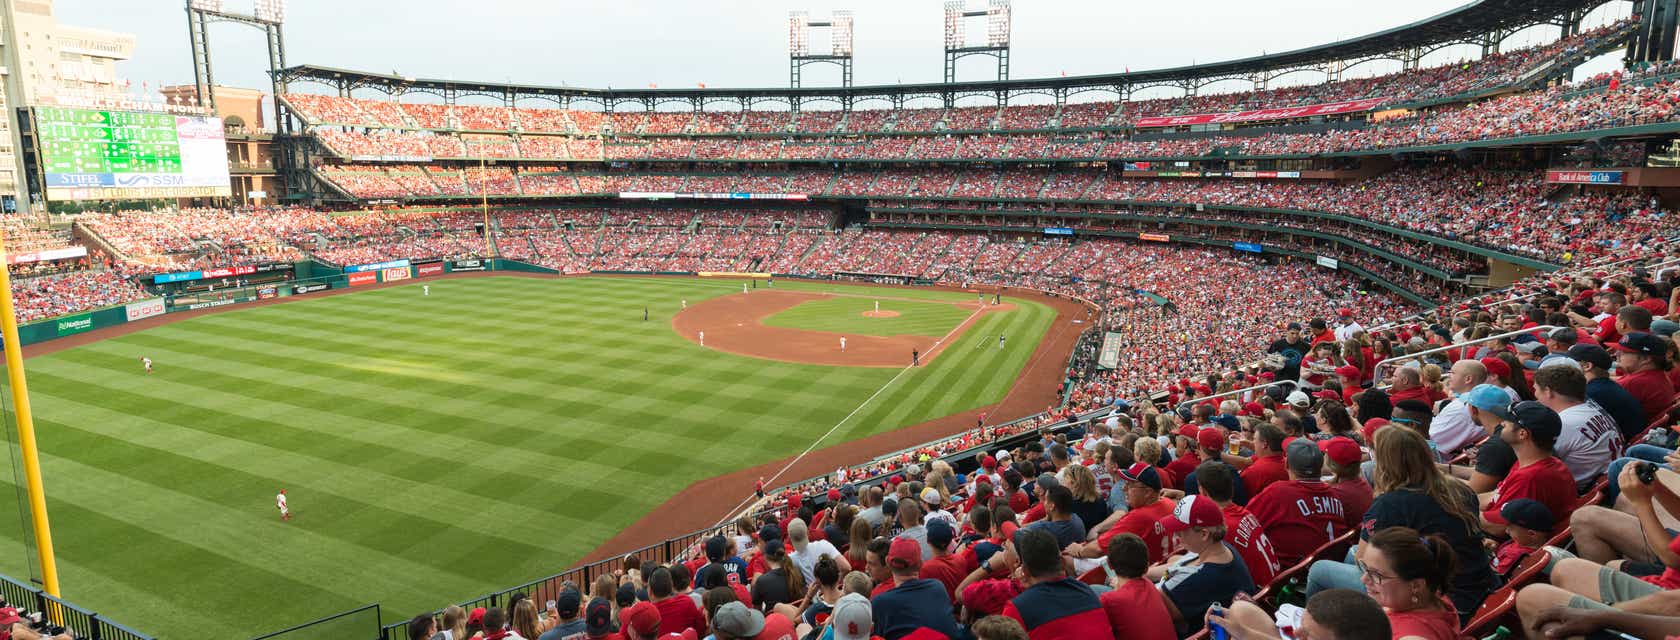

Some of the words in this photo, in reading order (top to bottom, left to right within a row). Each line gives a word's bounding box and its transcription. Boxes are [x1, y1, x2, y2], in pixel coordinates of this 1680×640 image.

[119, 101, 205, 114] CHAMPIONS
[61, 174, 103, 184] STIFEL
[153, 175, 184, 185] SSM
[1558, 172, 1570, 181] Bank
[1577, 173, 1597, 182] America
[1598, 173, 1610, 182] Club
[111, 187, 139, 198] LOUIS
[66, 318, 91, 329] National
[1326, 520, 1335, 543] 1
[1255, 534, 1281, 578] 13
